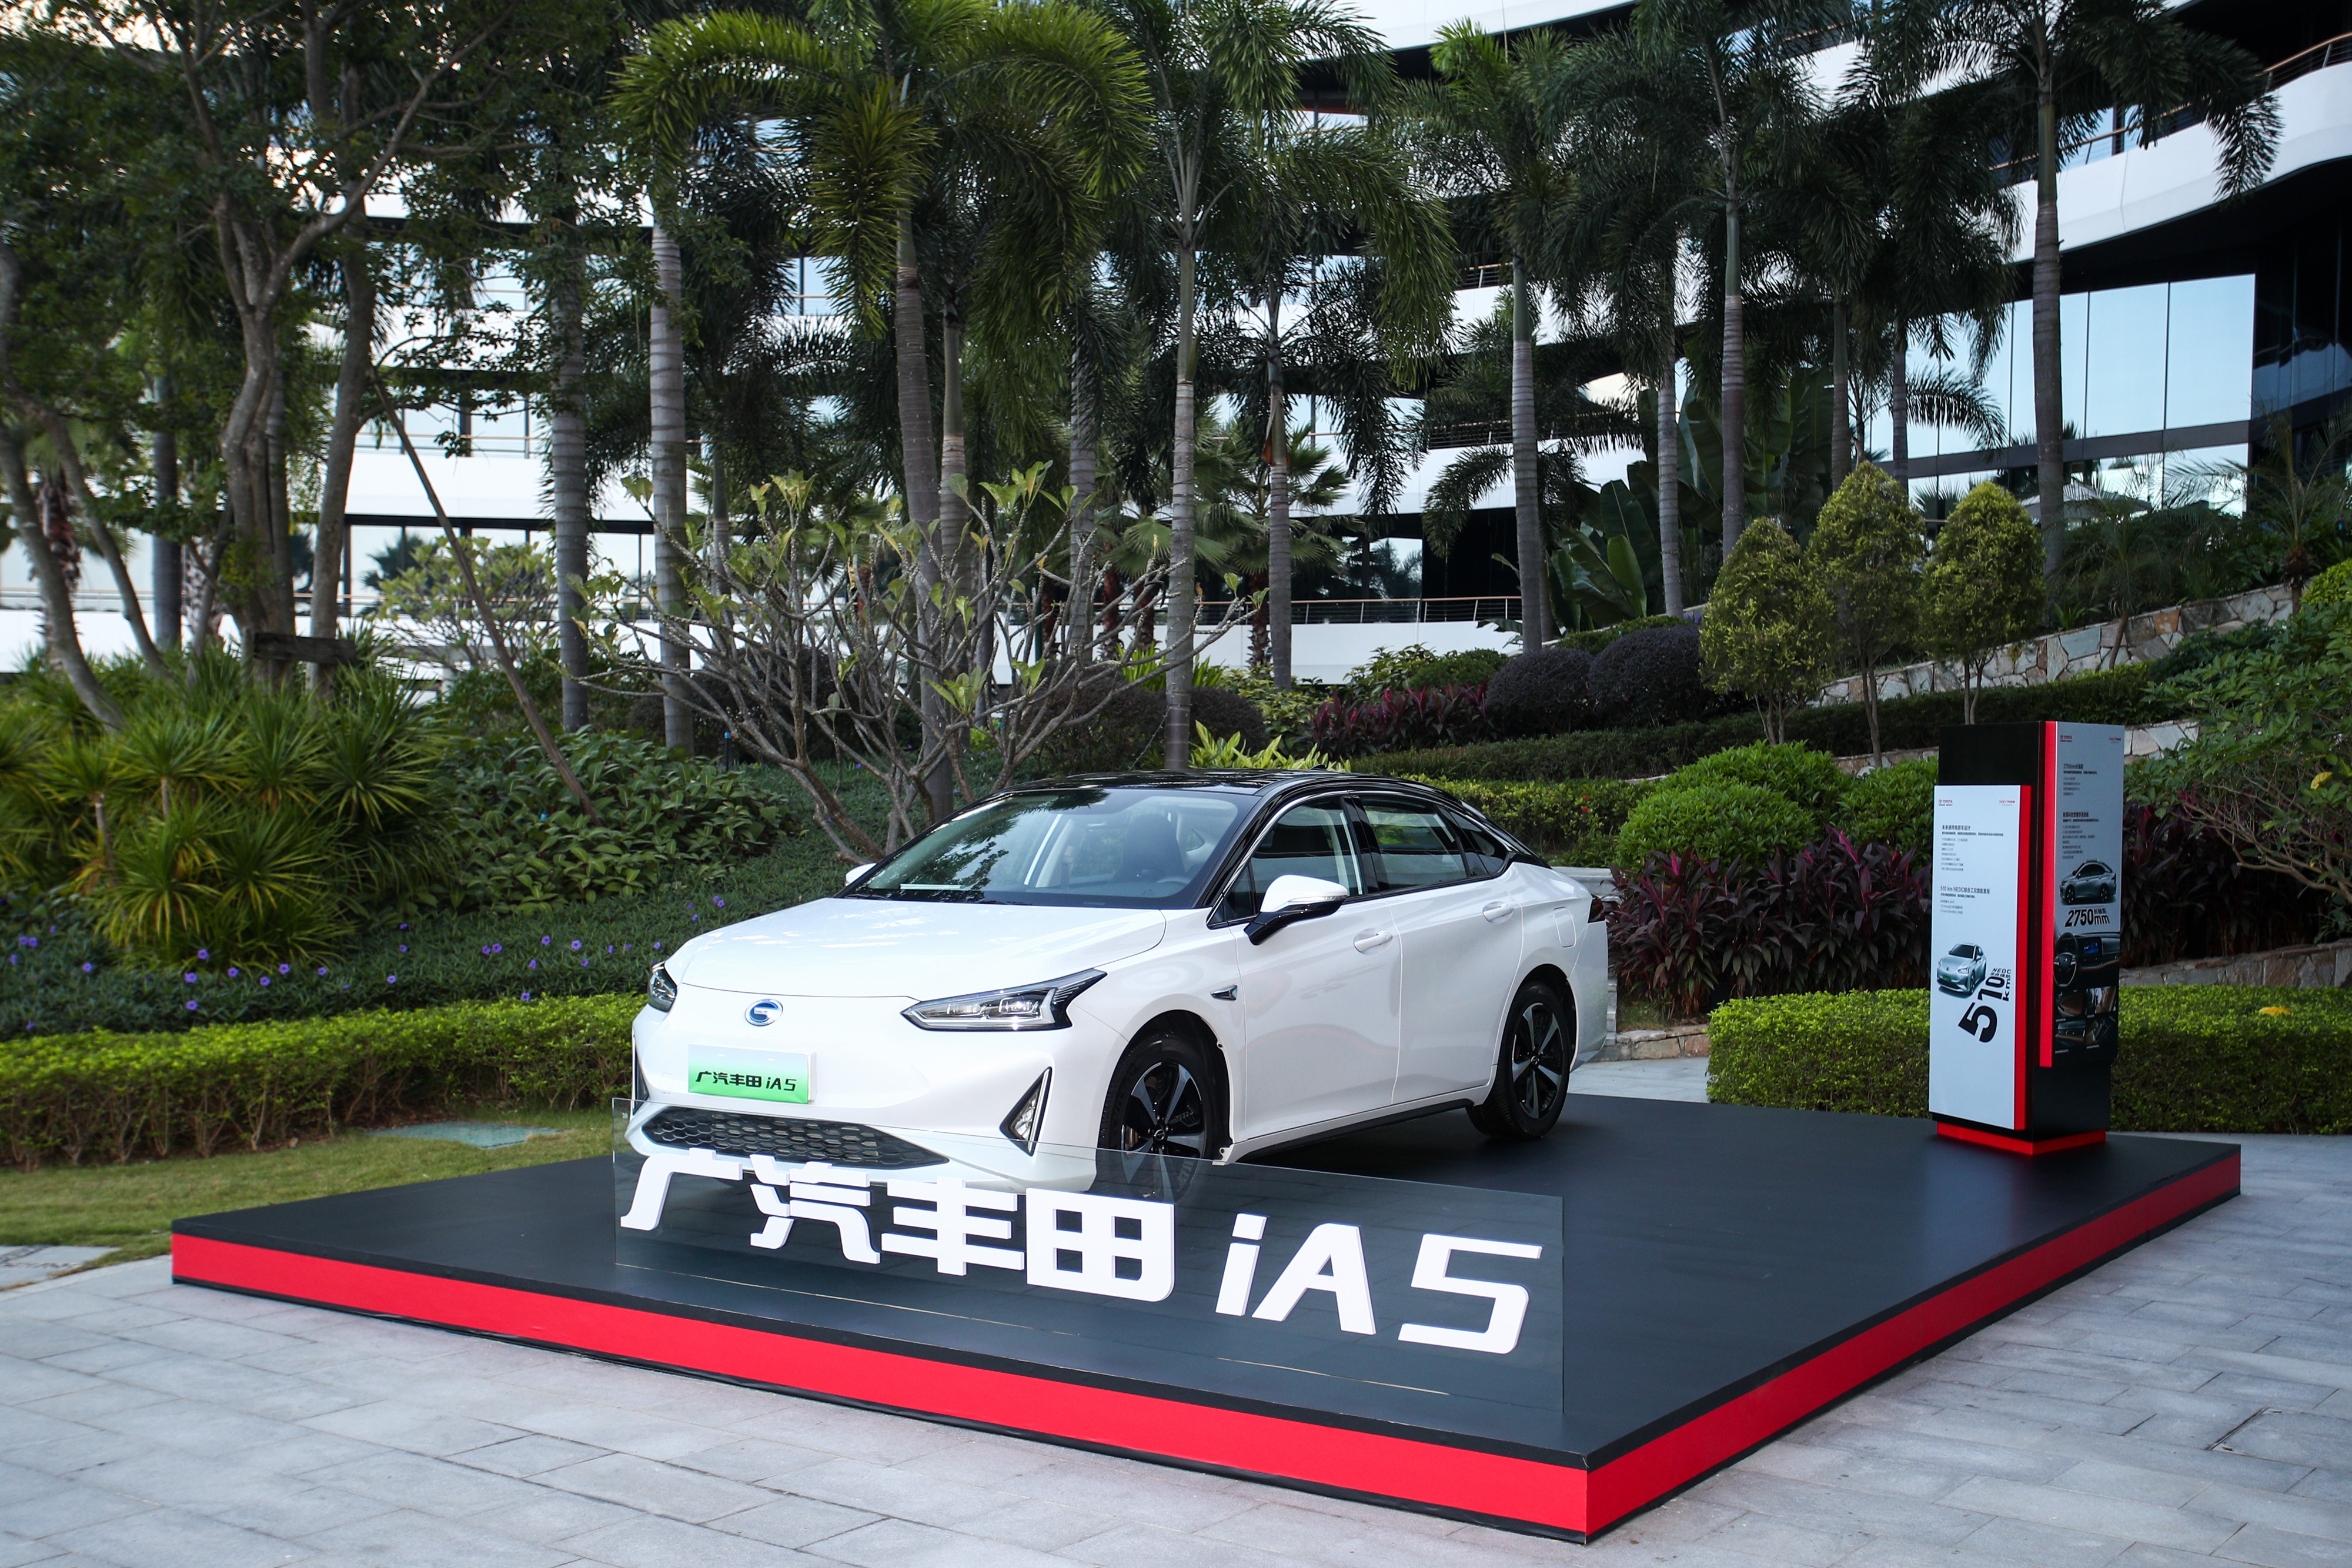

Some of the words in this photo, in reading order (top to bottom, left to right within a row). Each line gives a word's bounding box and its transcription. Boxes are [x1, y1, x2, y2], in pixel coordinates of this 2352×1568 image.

[695, 1071, 762, 1088] 广汽丰田
[765, 1076, 797, 1092] iA5
[620, 1148, 1176, 1302] 广汽丰田
[1215, 1212, 1543, 1355] iA5
